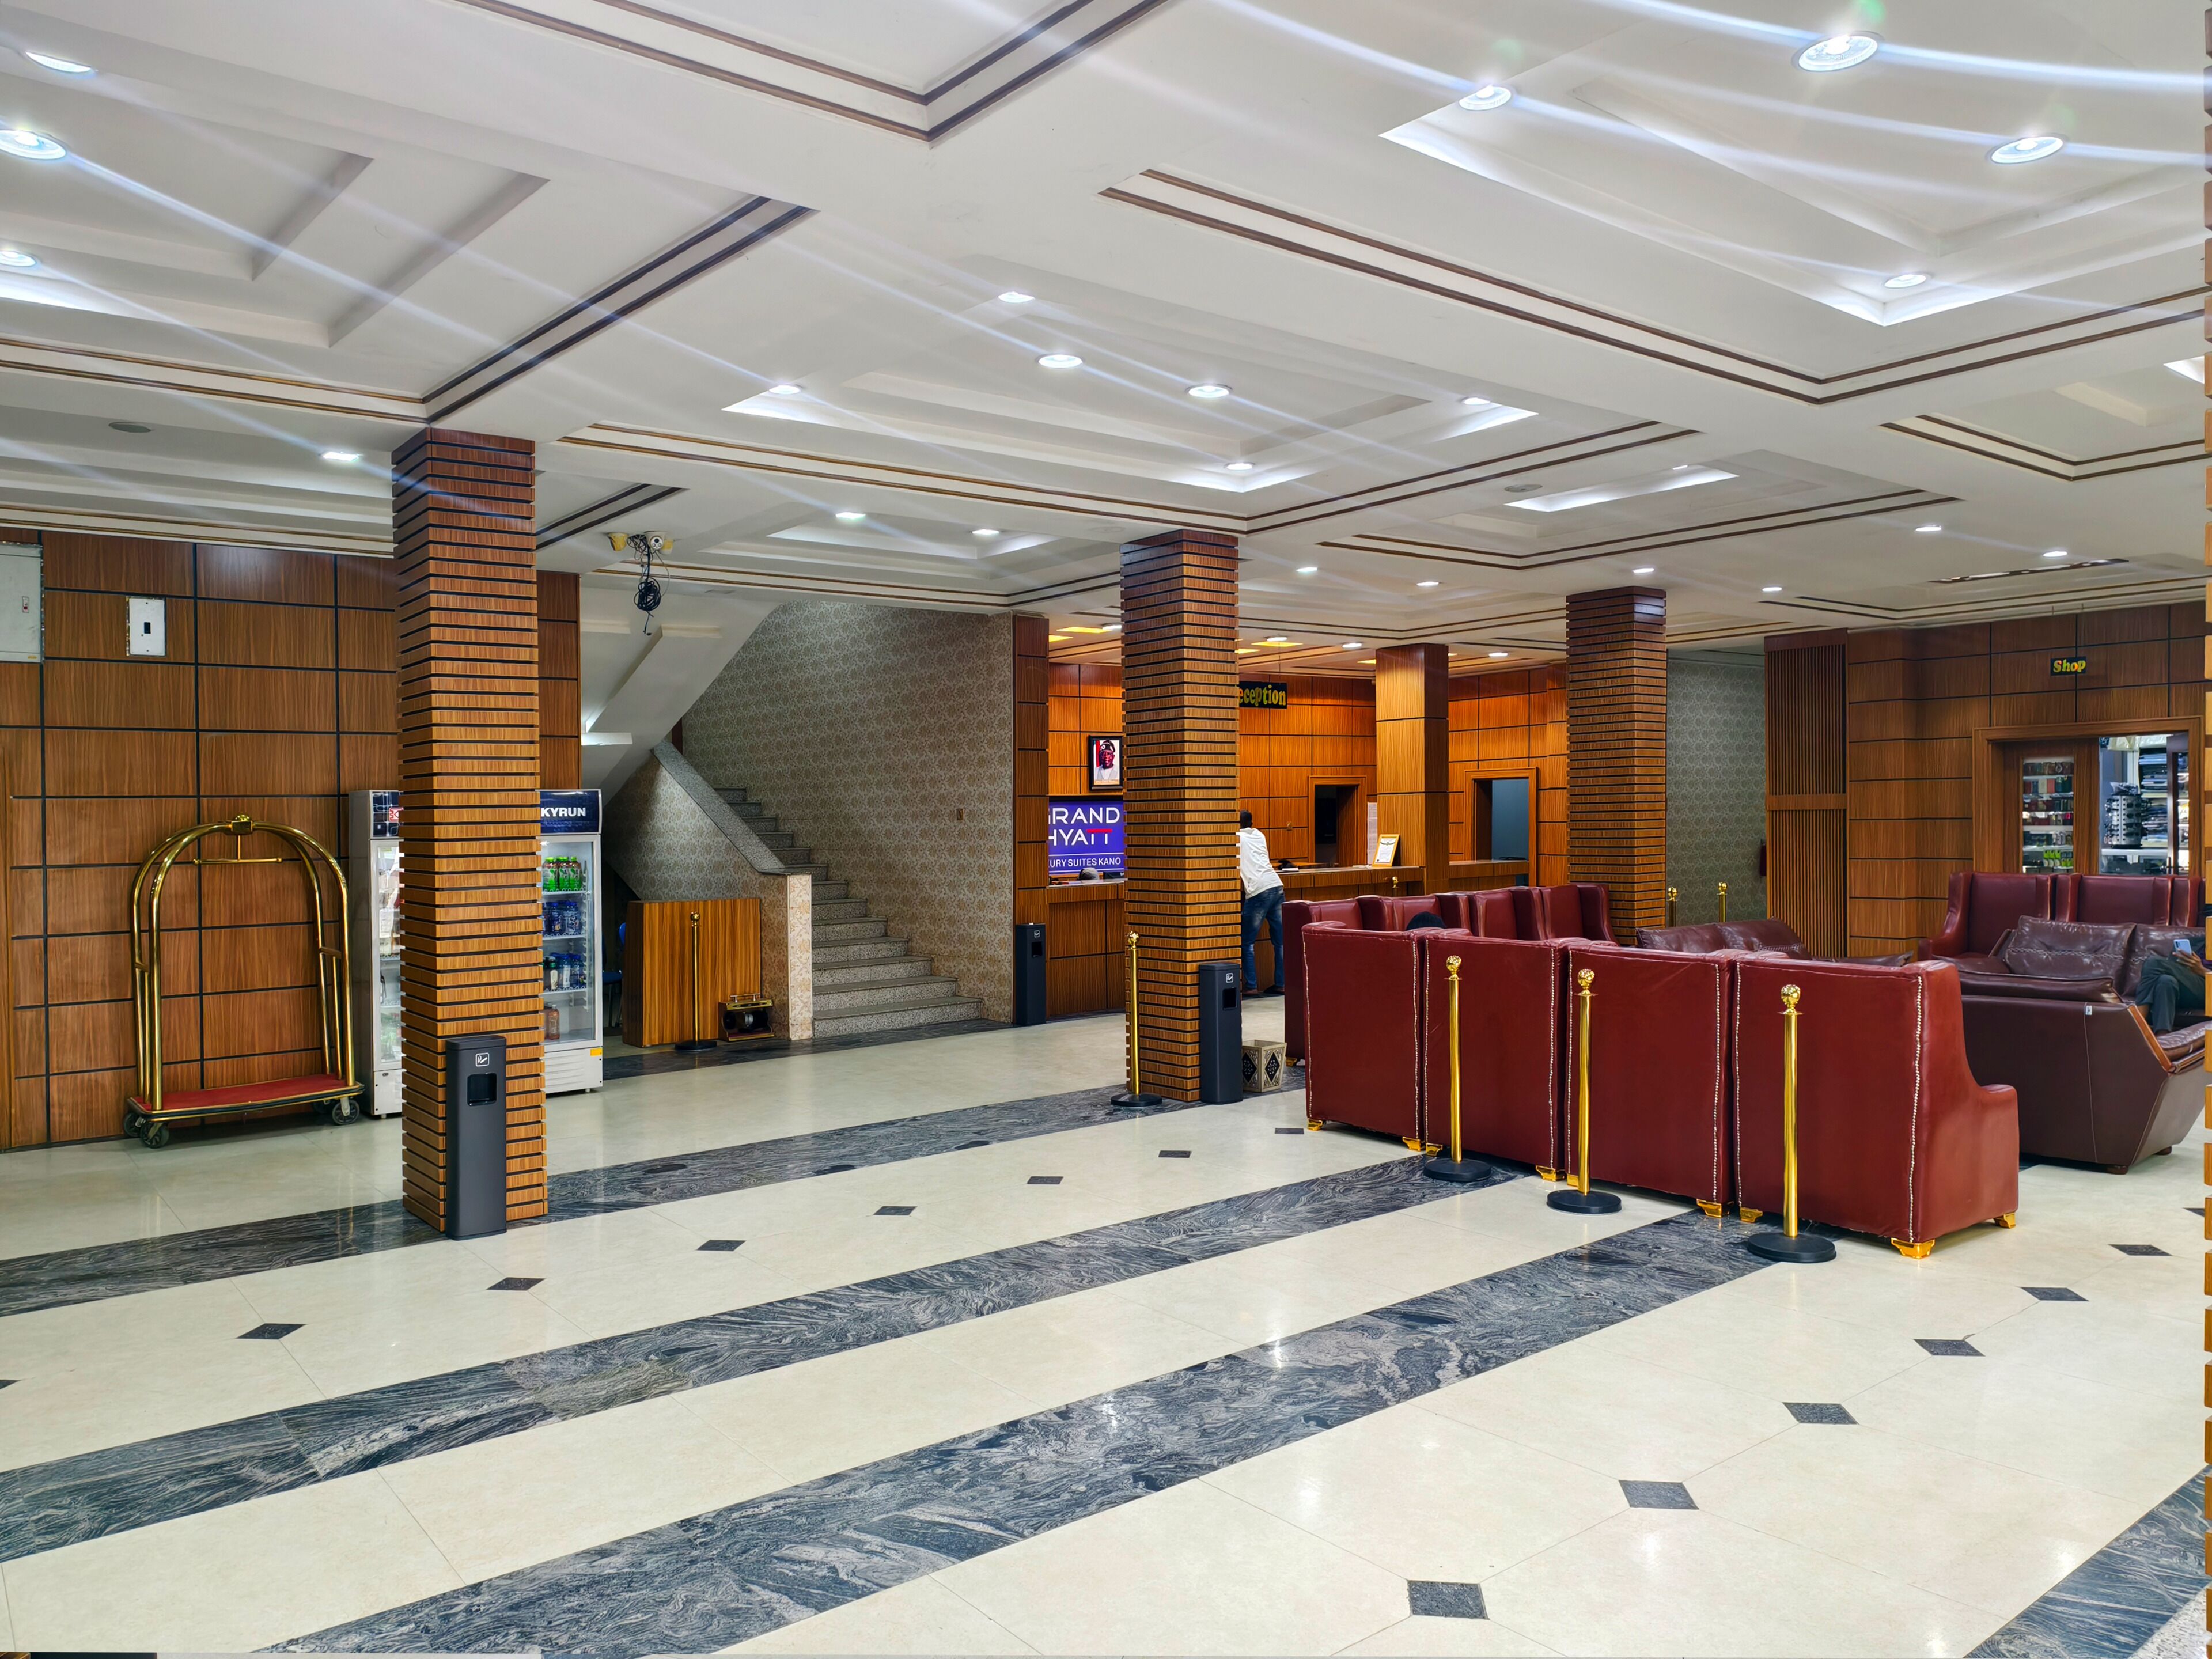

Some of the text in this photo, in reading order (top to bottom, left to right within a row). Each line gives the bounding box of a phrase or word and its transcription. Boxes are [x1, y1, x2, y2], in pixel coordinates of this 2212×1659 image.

[2053, 659, 2086, 673] Shop
[1239, 684, 1286, 706] eception
[541, 807, 586, 817] KYRUN
[1048, 807, 1120, 824] RAND
[1049, 857, 1121, 868] URY SUITES KANO
